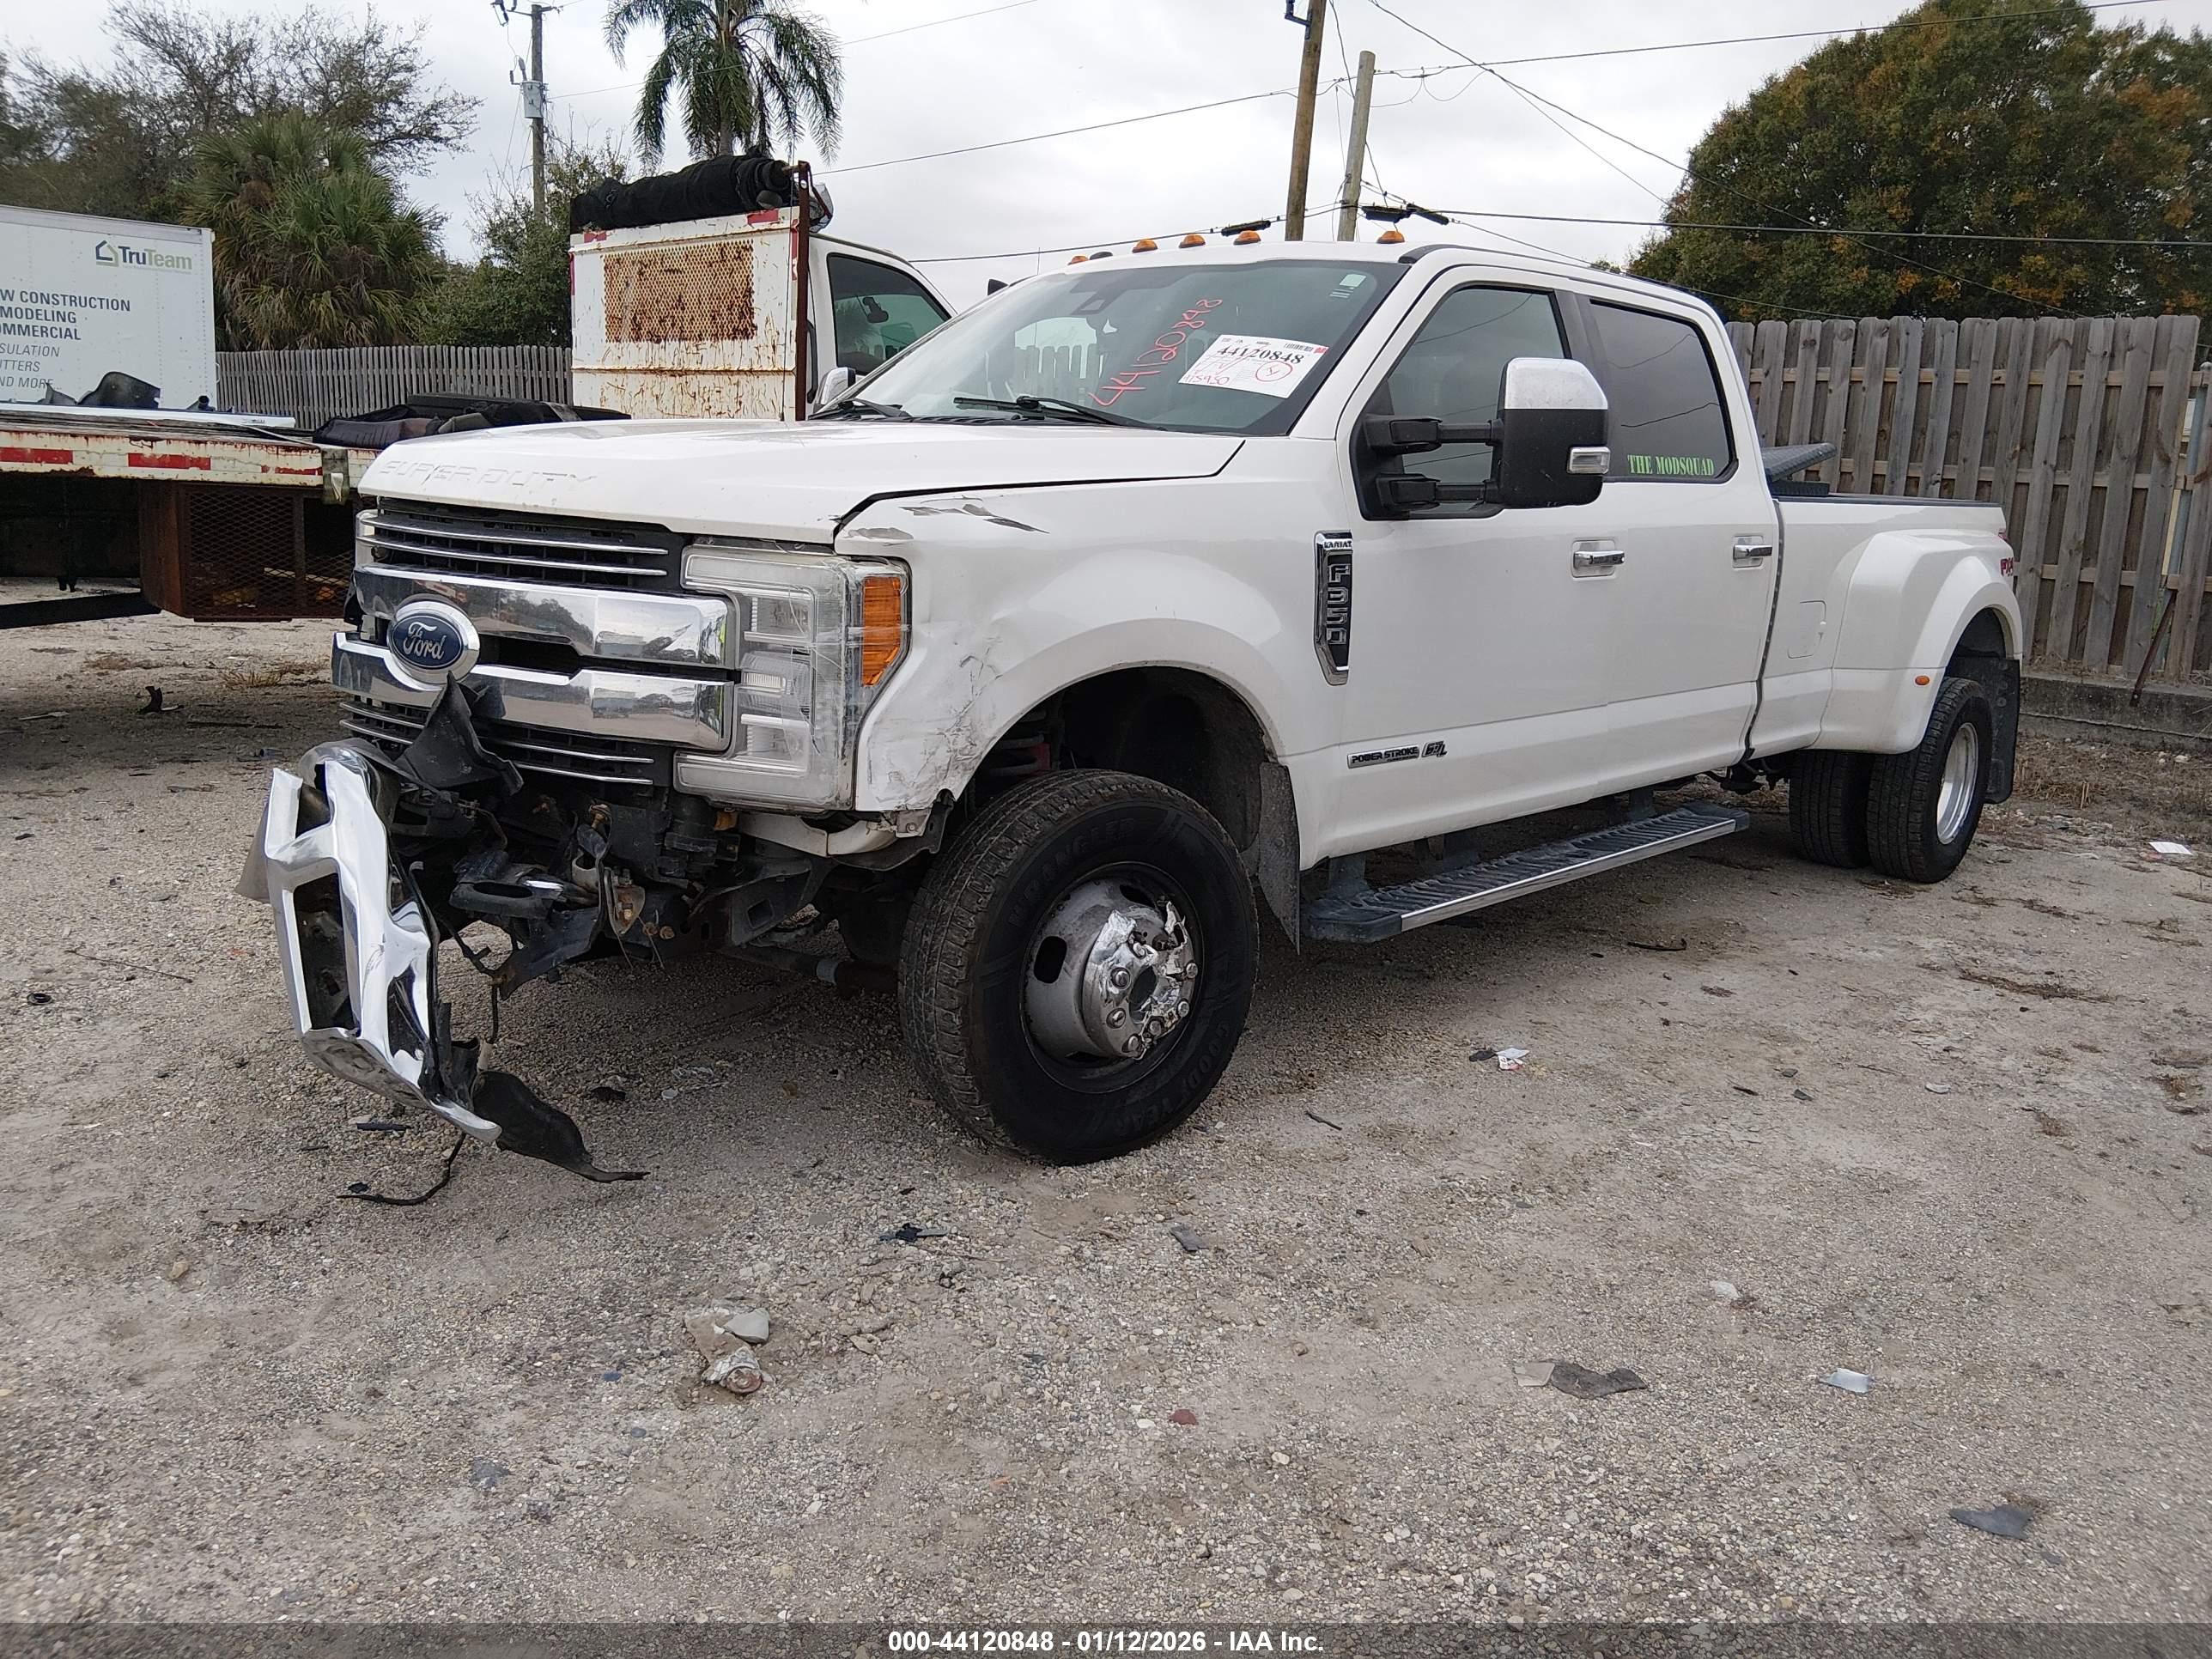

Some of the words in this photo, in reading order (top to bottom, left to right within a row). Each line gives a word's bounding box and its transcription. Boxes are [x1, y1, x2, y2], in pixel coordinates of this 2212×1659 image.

[118, 246, 192, 270] TruTeam
[20, 290, 131, 312] CONSTRUCTION
[1217, 345, 1305, 364] 44120848
[380, 460, 477, 483] SUPER
[1627, 454, 1653, 474] THE
[1656, 456, 1715, 476] MODSQUAD
[1323, 540, 1352, 549] LARIAT
[403, 622, 447, 660] Ford
[1351, 751, 1382, 764] POWER
[1383, 746, 1419, 759] STROKE
